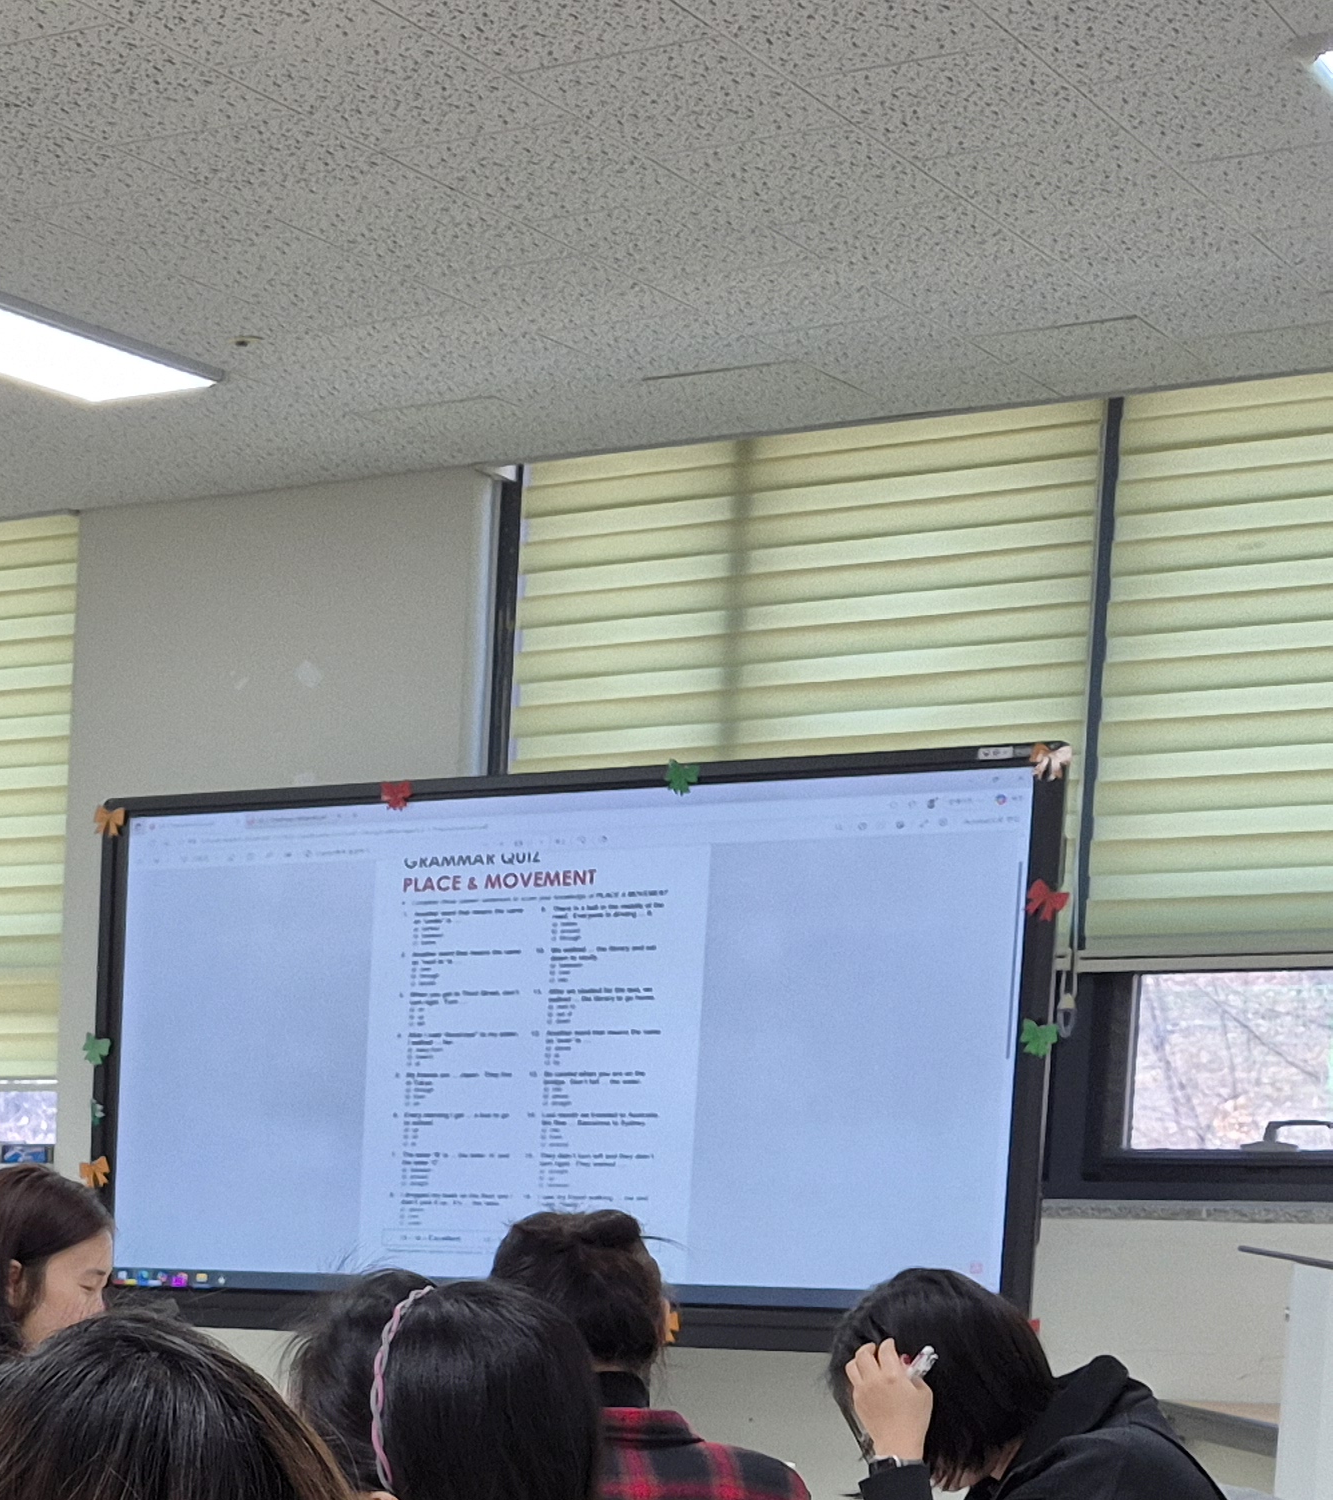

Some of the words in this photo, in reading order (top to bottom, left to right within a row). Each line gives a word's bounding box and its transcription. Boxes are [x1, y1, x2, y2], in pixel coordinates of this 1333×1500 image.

[402, 875, 462, 893] PLACE
[466, 877, 478, 891] &
[484, 868, 597, 890] MOVEMENT
